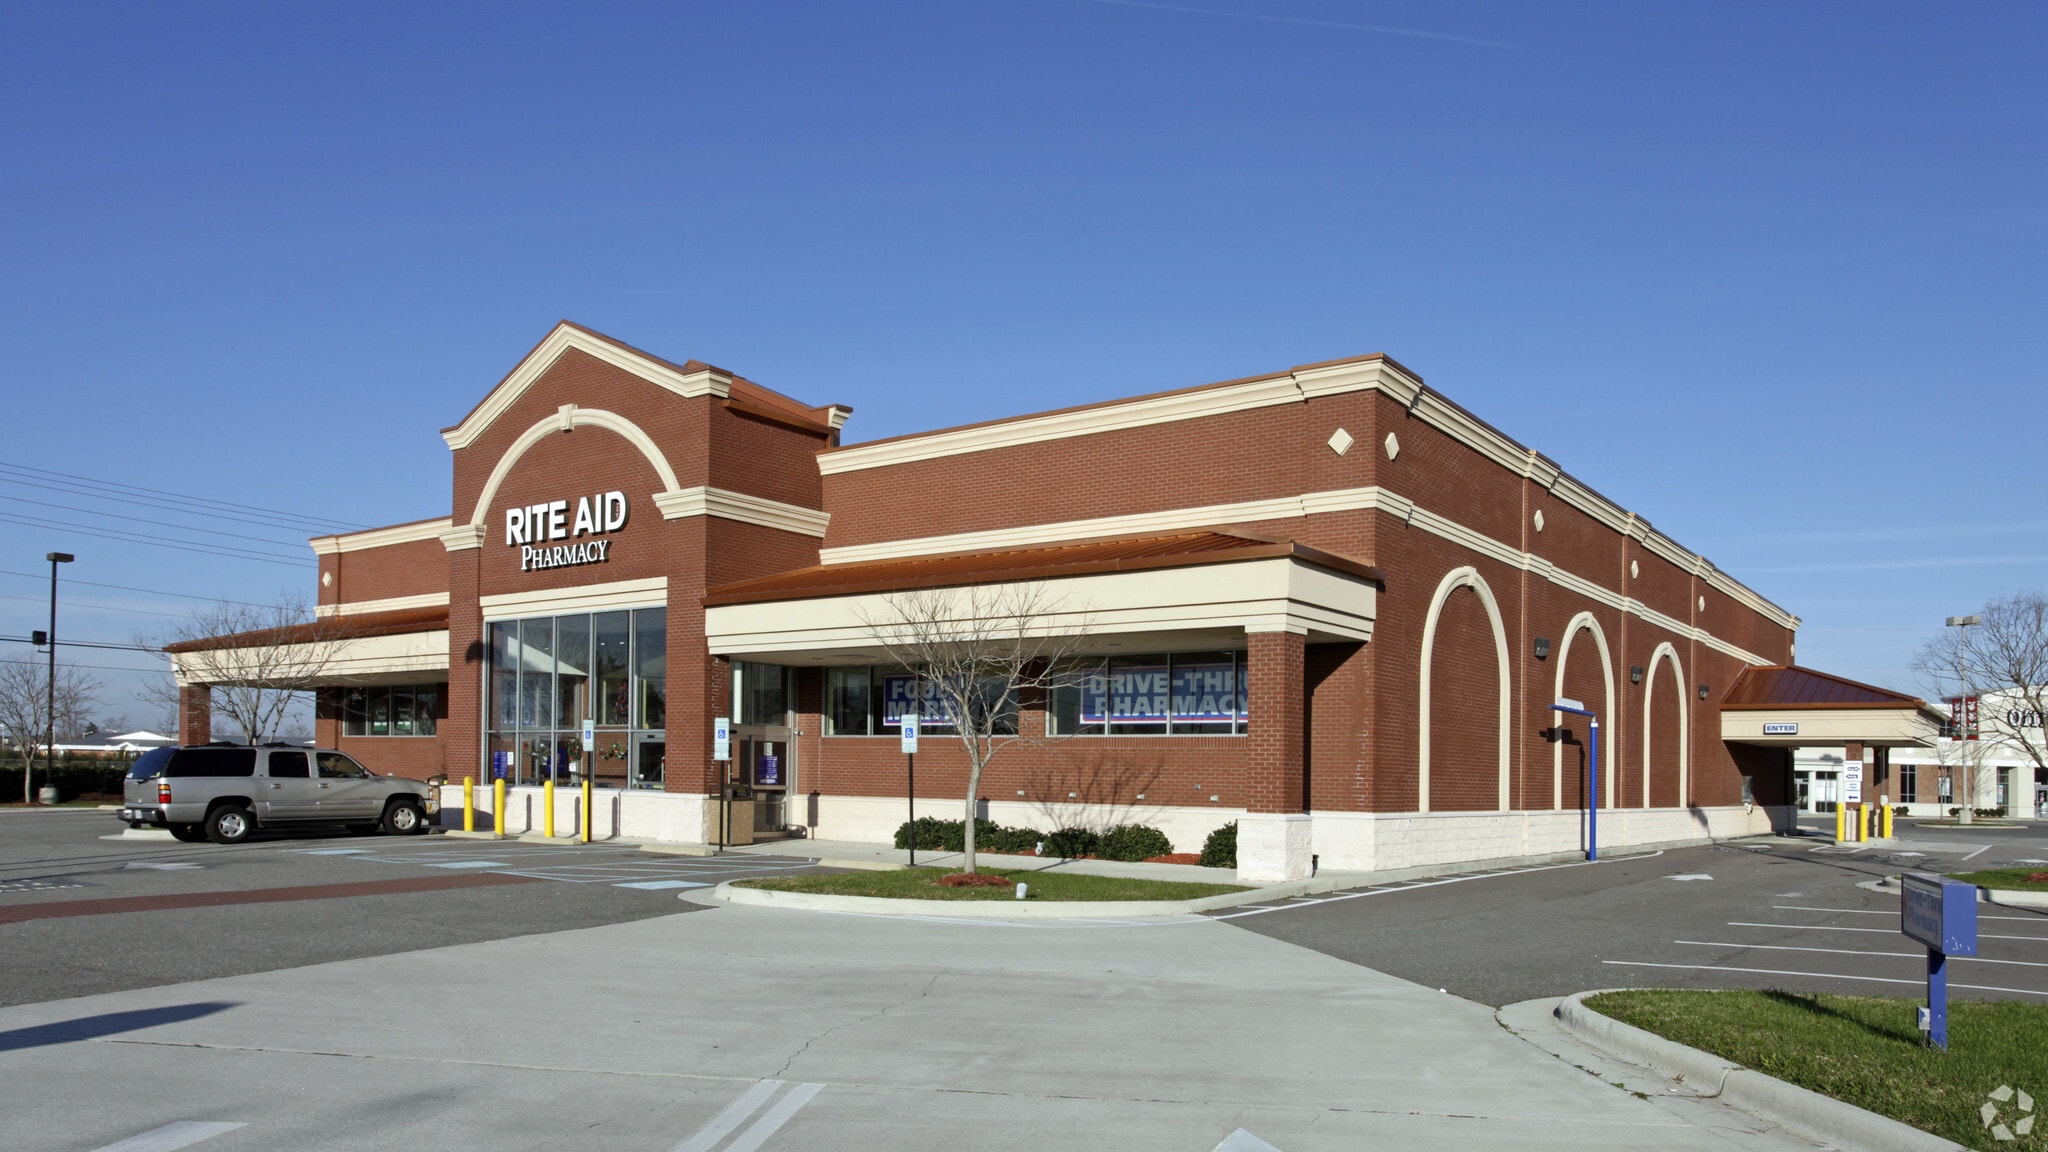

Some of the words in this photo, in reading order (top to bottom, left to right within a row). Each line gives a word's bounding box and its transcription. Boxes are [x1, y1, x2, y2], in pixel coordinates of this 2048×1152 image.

[506, 500, 567, 545] RITE
[573, 490, 627, 536] AID
[521, 540, 608, 570] PHARMACY
[1090, 671, 1248, 695] DRIVE-THR
